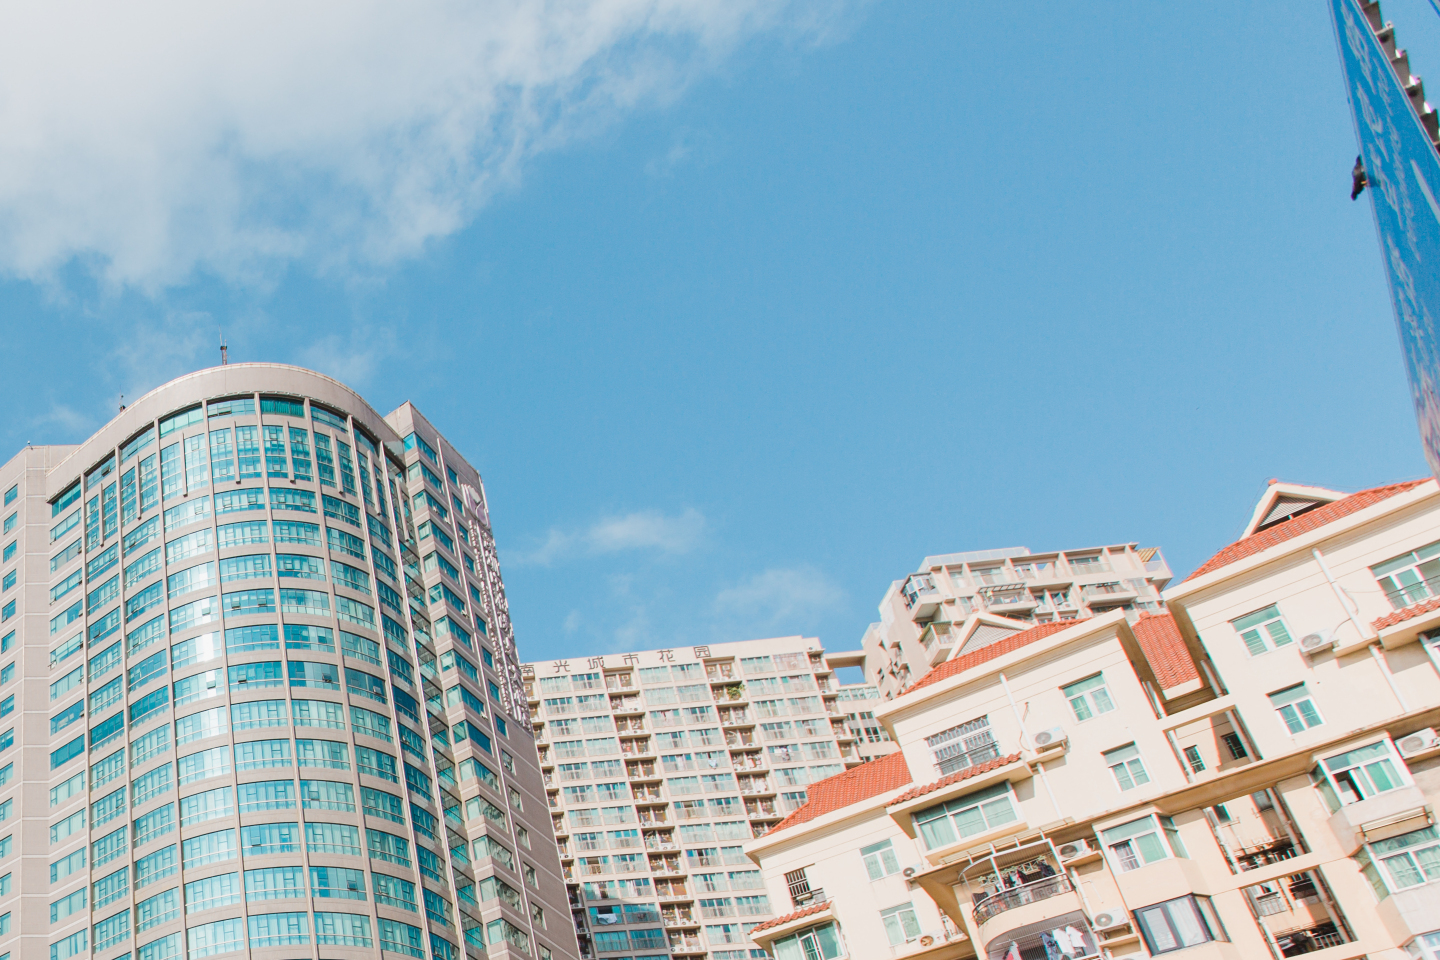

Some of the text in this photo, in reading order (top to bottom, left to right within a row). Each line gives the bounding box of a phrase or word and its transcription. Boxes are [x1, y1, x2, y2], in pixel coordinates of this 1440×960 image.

[520, 646, 711, 677] 南光城市花园
